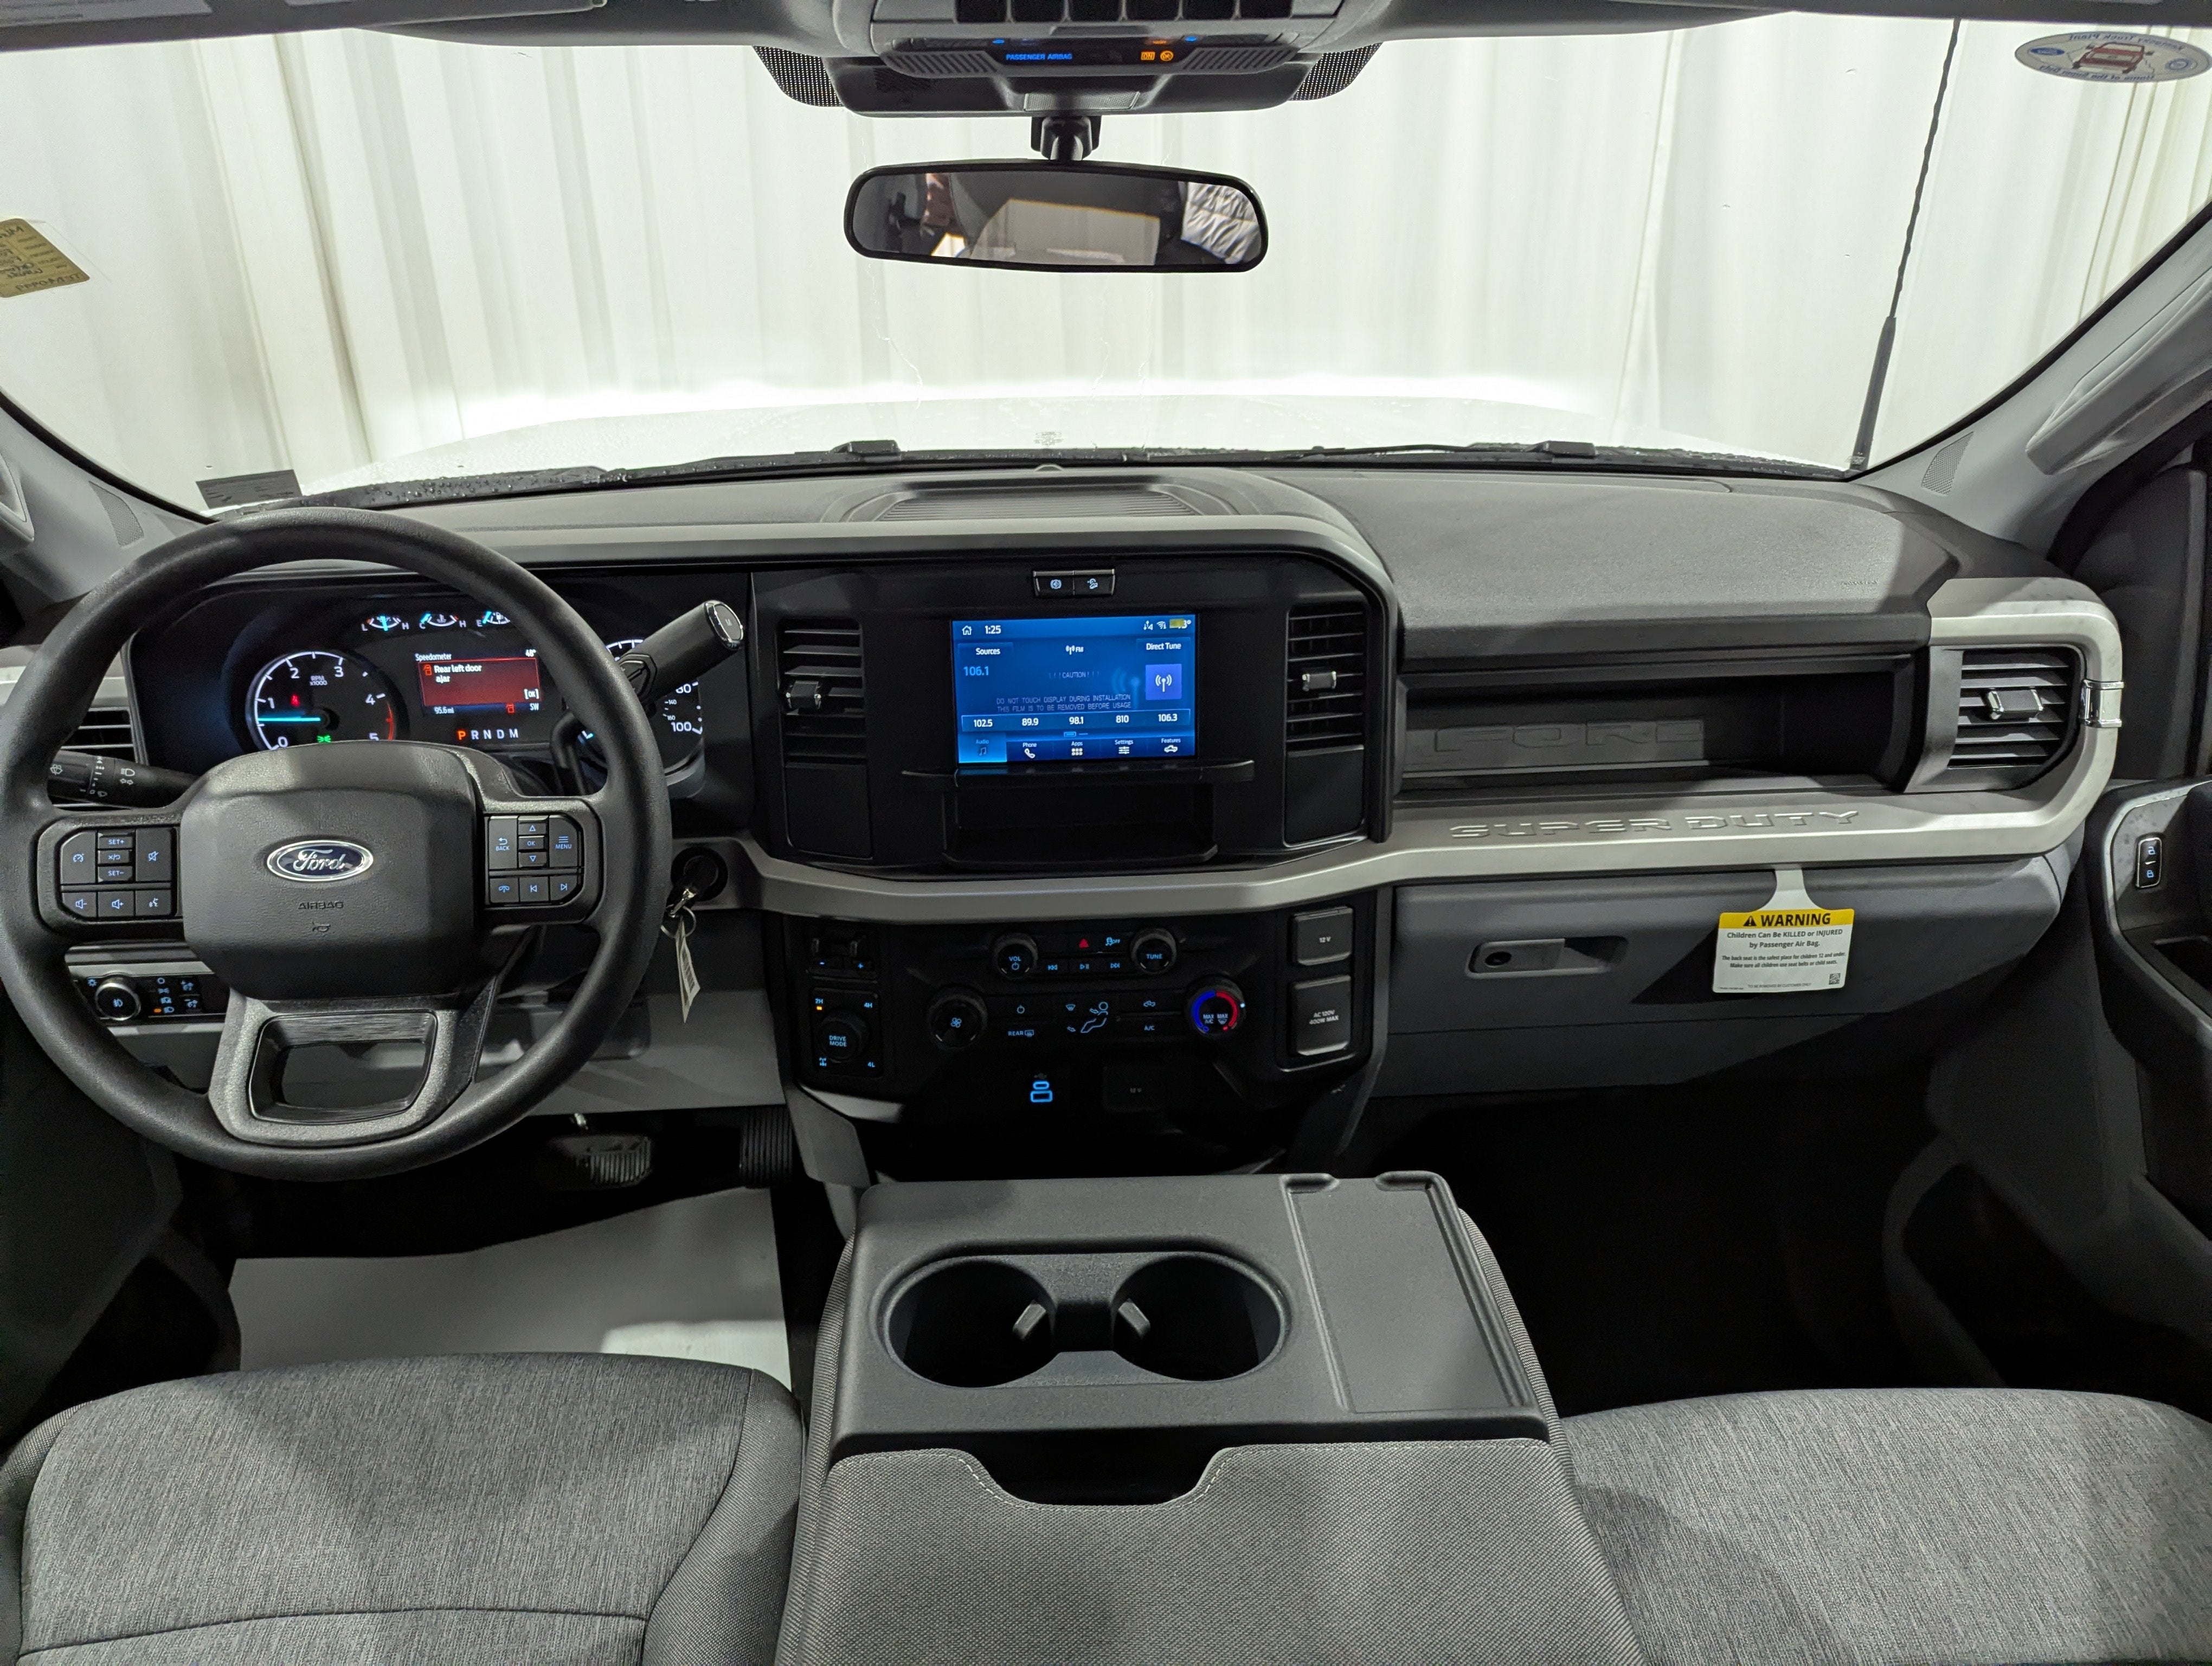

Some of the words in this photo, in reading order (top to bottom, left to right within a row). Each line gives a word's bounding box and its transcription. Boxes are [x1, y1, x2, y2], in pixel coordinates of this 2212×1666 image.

[985, 625, 1001, 634] 1:25
[415, 653, 452, 662] Speedometer
[290, 668, 300, 678] 2
[334, 666, 344, 677] 3
[434, 665, 451, 673] Rear
[451, 664, 465, 672] left
[465, 664, 482, 672] door
[963, 666, 989, 676] 106.1
[435, 675, 450, 683] ajar
[365, 694, 376, 705] 4
[1093, 694, 1131, 702] INSTALLATION
[267, 697, 275, 709] 1
[1021, 717, 1039, 726] 89.9
[1069, 716, 1084, 725] 98.1
[1116, 715, 1129, 723] 810
[1158, 713, 1178, 722] 106.3
[671, 721, 692, 732] 100
[974, 719, 993, 728] 102.5
[458, 730, 466, 740] P
[471, 730, 479, 740] R
[483, 729, 492, 739] N
[497, 729, 505, 739] D
[509, 728, 519, 738] M
[278, 736, 288, 747] 0
[1449, 818, 1673, 839] SUPER
[1684, 810, 1860, 830] DUTY
[293, 849, 346, 872] Ford
[298, 901, 344, 910] AIRBAG
[1760, 913, 1831, 927] WARNING
[1816, 929, 1843, 937] INJURED
